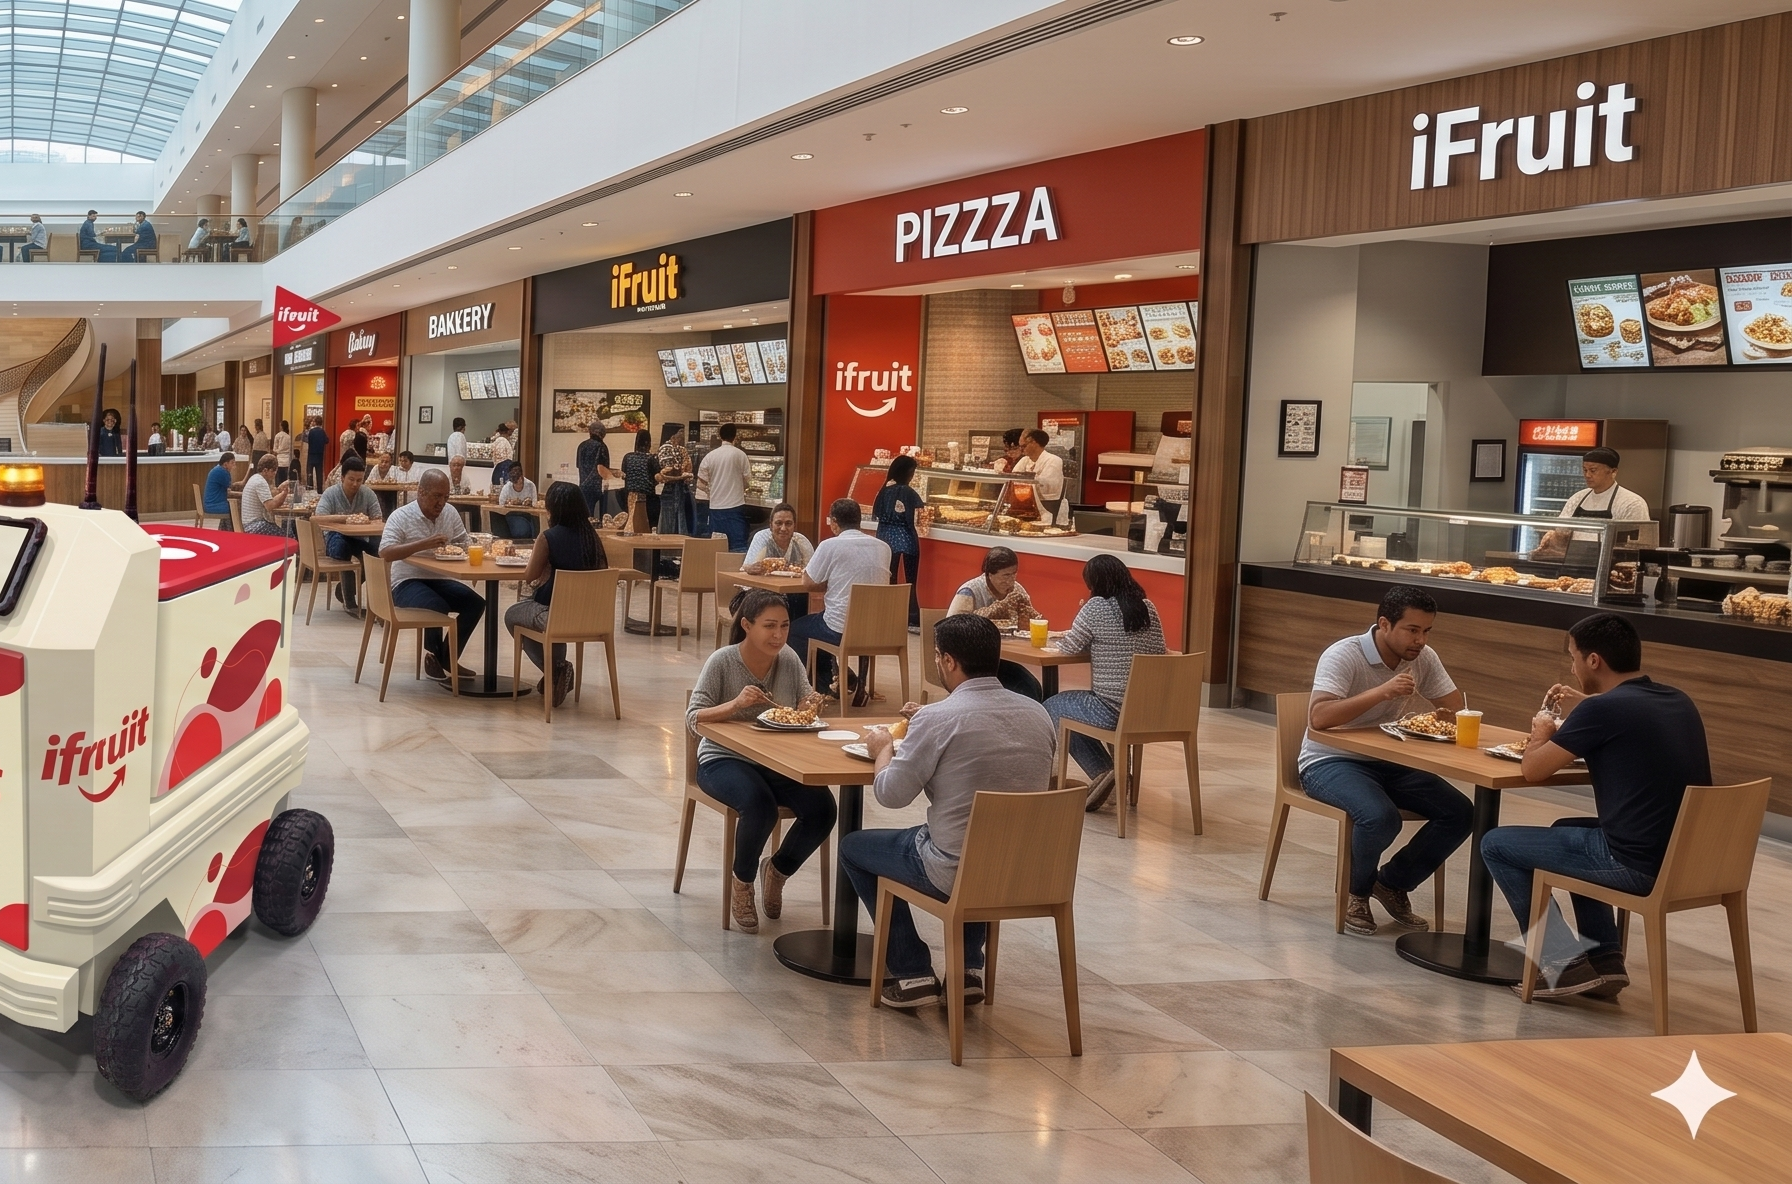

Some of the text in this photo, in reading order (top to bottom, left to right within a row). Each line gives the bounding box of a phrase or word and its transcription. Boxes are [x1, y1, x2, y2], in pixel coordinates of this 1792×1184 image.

[1410, 81, 1636, 191] iFruit
[895, 186, 1058, 263] PIZZZA
[611, 252, 679, 309] iFruit
[835, 361, 912, 392] ifruit
